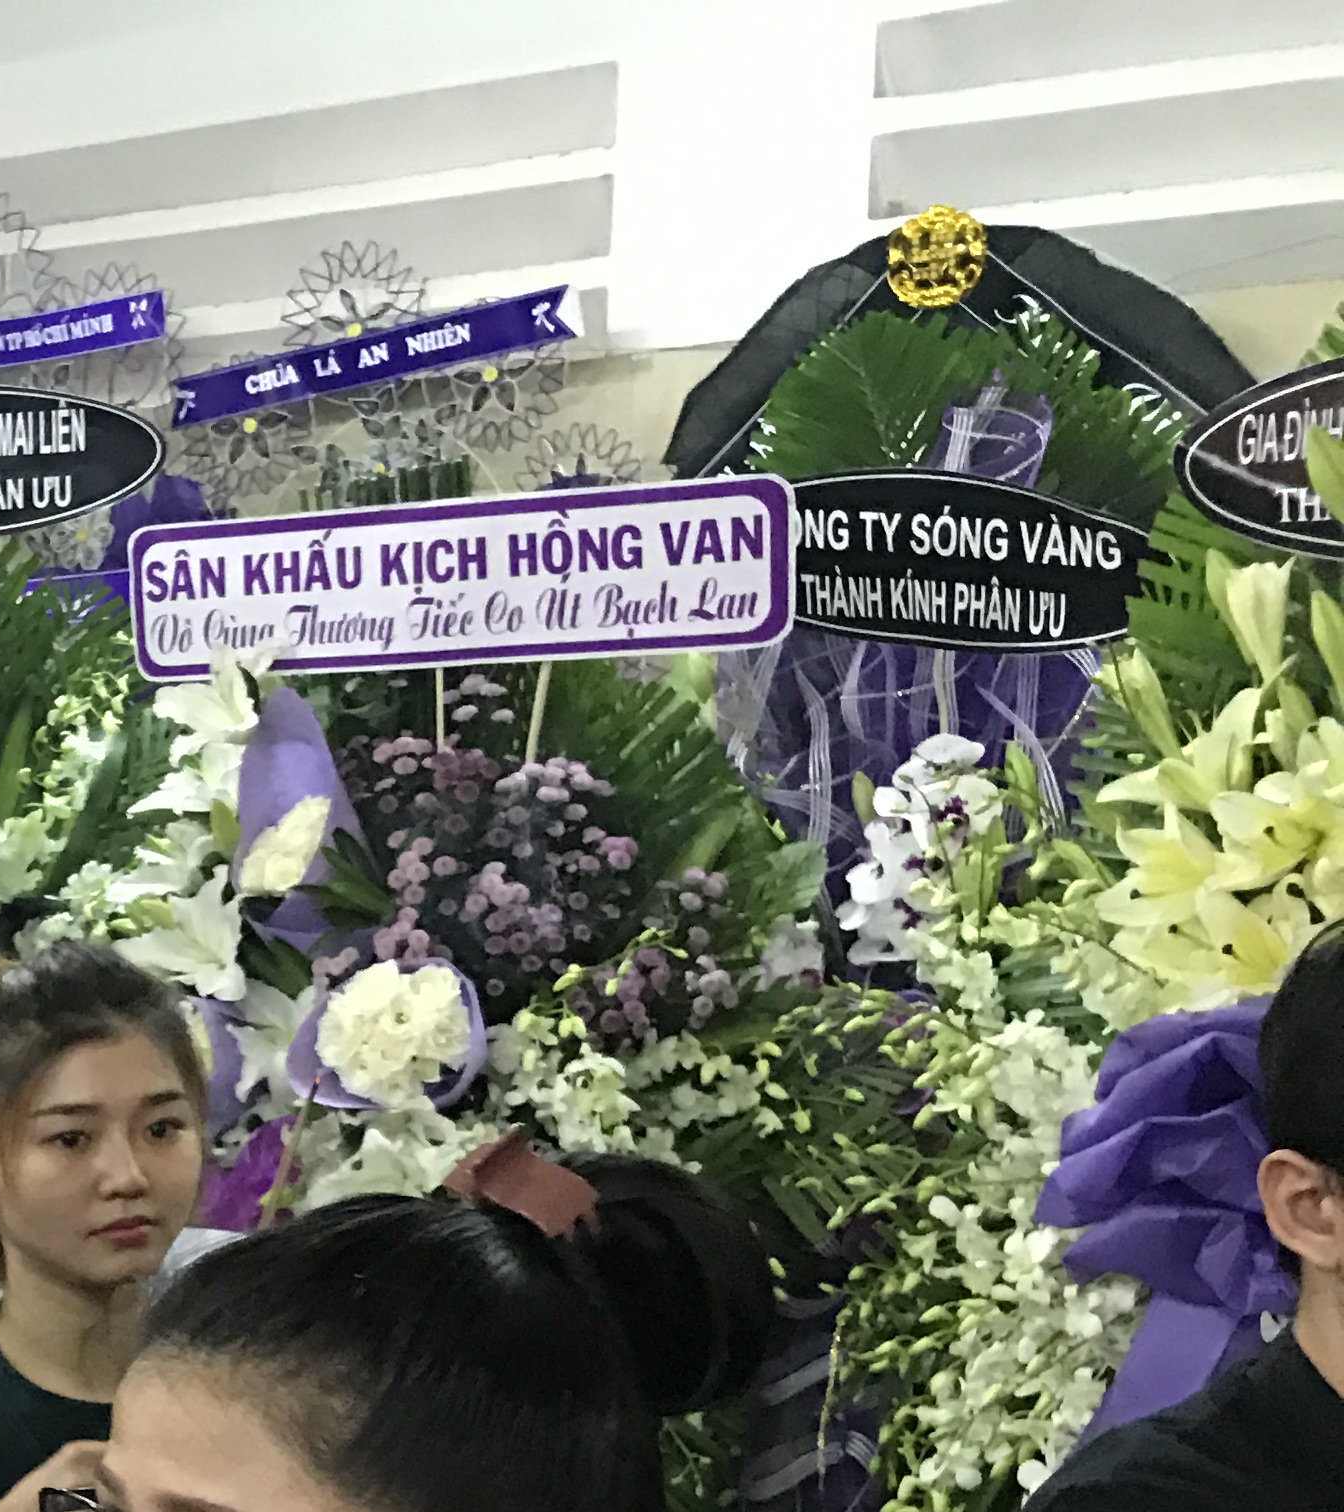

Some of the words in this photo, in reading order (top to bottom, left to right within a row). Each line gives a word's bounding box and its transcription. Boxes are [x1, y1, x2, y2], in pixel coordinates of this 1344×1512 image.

[357, 342, 390, 369] AN
[404, 322, 471, 356] NHIÊN
[39, 399, 86, 454] LIÊN
[1238, 412, 1278, 465] GIA
[32, 475, 72, 509] ƯU
[146, 549, 226, 602] SÂN
[243, 529, 362, 596] KHẤU
[380, 536, 488, 595] KỊCH
[508, 508, 643, 577] HỒNG
[660, 514, 763, 567] VAN
[859, 511, 902, 553] TY
[910, 505, 1009, 561] SÓNG
[1020, 513, 1122, 570] VÀNG
[151, 613, 193, 655] Vô
[284, 605, 395, 652] Thương
[406, 593, 473, 641] Tiếc
[594, 580, 677, 638] Bạch
[688, 577, 758, 622] Lan
[800, 565, 883, 618] THÀNH
[890, 568, 947, 624] KÍNH
[954, 575, 1021, 633] PHÂN
[1029, 589, 1066, 638] ƯU
